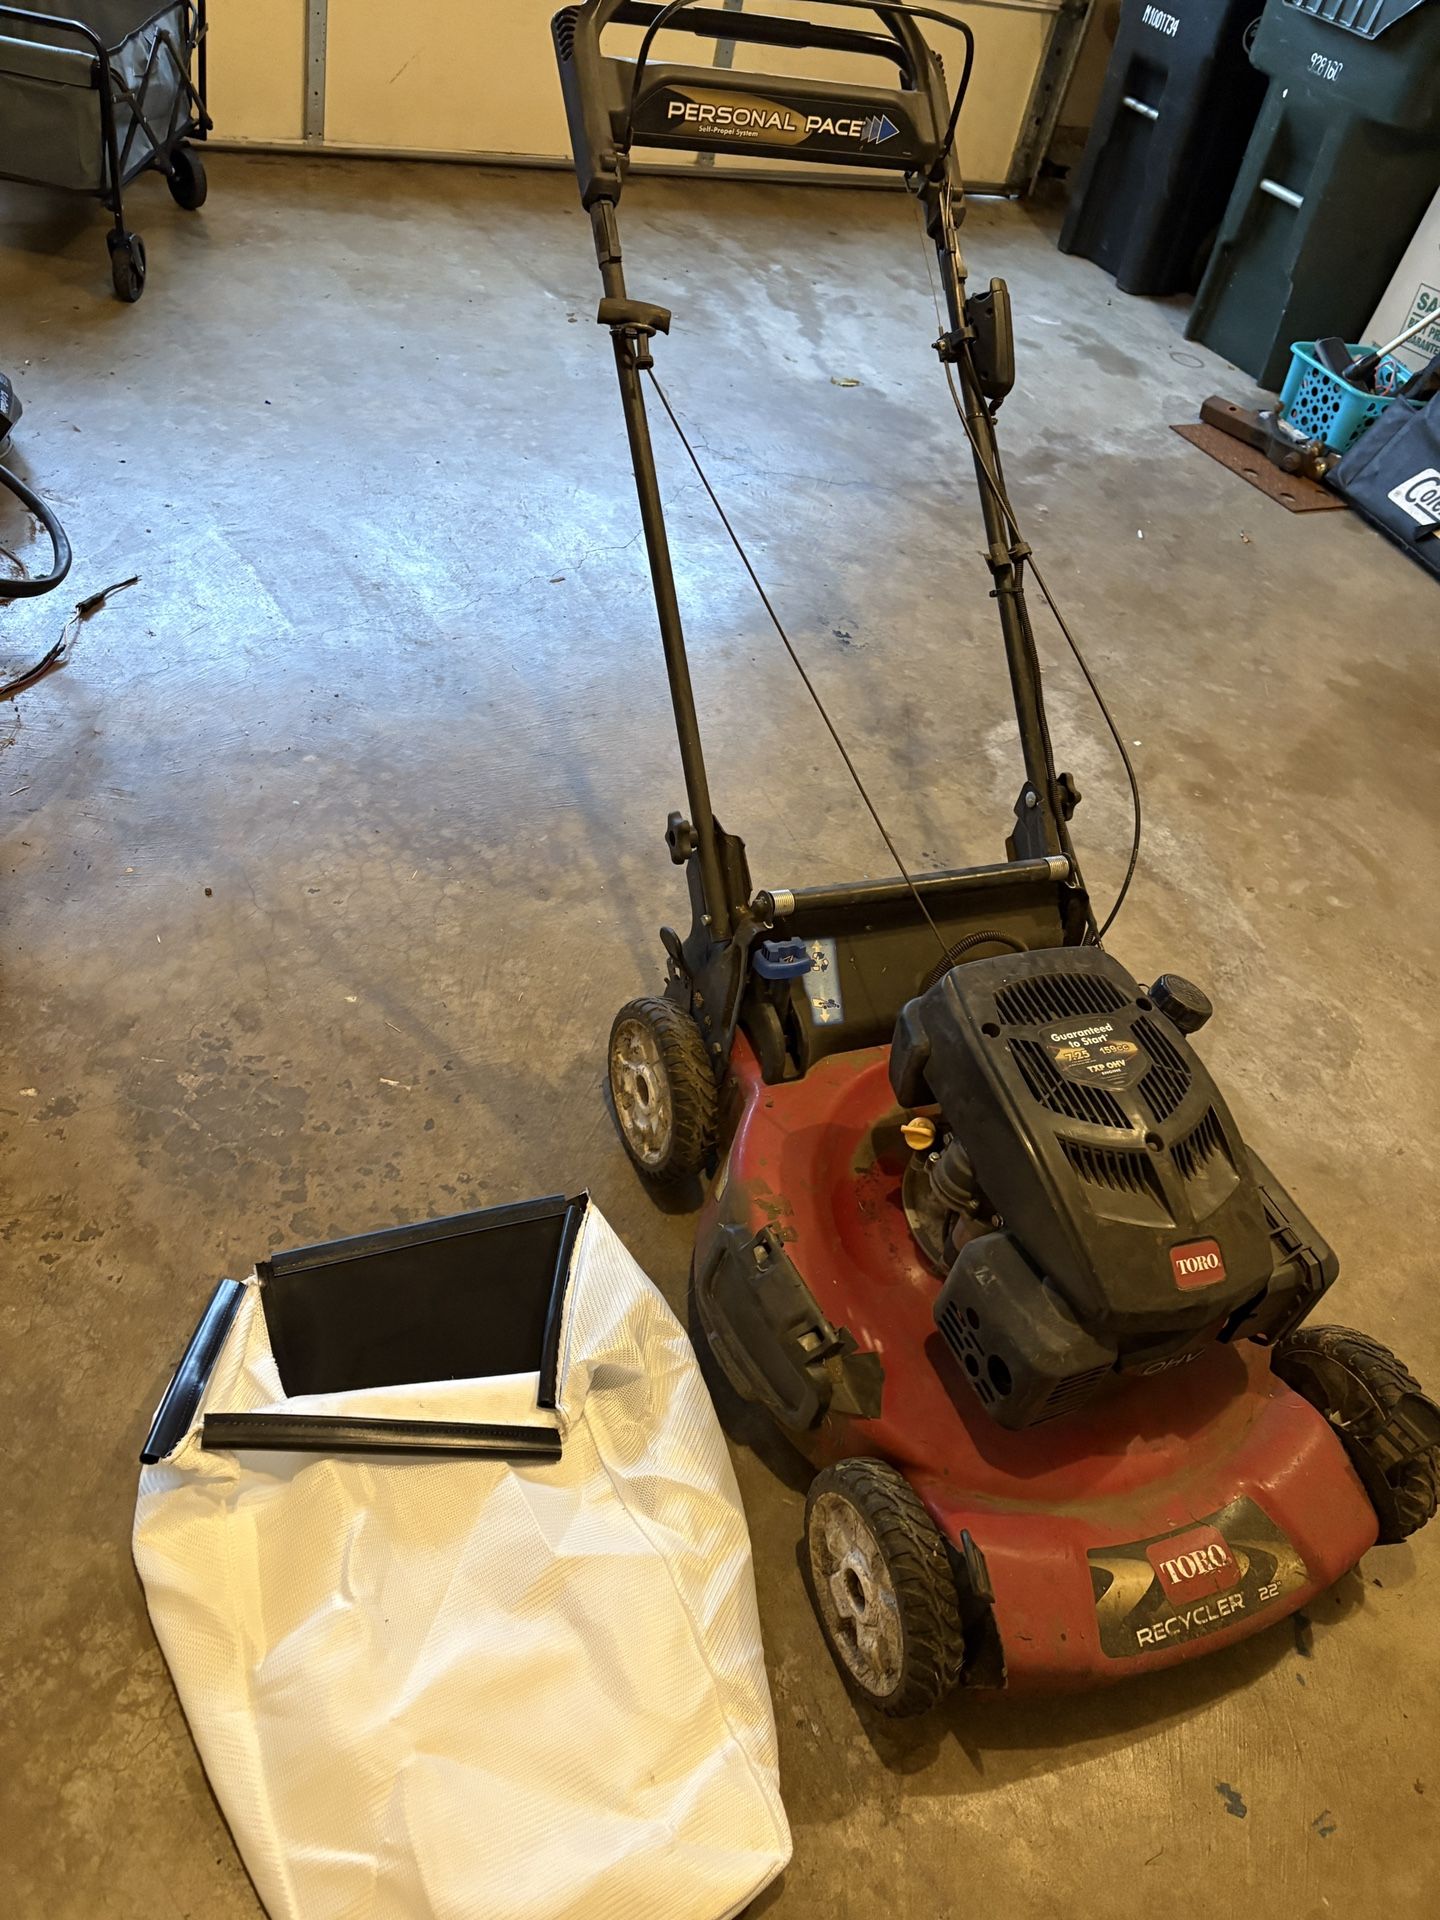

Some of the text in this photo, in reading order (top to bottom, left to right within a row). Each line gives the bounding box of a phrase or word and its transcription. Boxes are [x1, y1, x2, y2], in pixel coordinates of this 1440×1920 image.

[667, 101, 865, 137] PERSONAL PACE
[698, 124, 759, 138] Self-Propel System
[1050, 1022, 1114, 1043] Guaranteed
[1068, 1040, 1081, 1049] to
[1099, 1043, 1130, 1055] 159cc
[1086, 1063, 1106, 1073] TXP
[1176, 1252, 1219, 1275] TORO
[1159, 1543, 1228, 1585] TORO
[1136, 1592, 1246, 1648] RECYCLER
